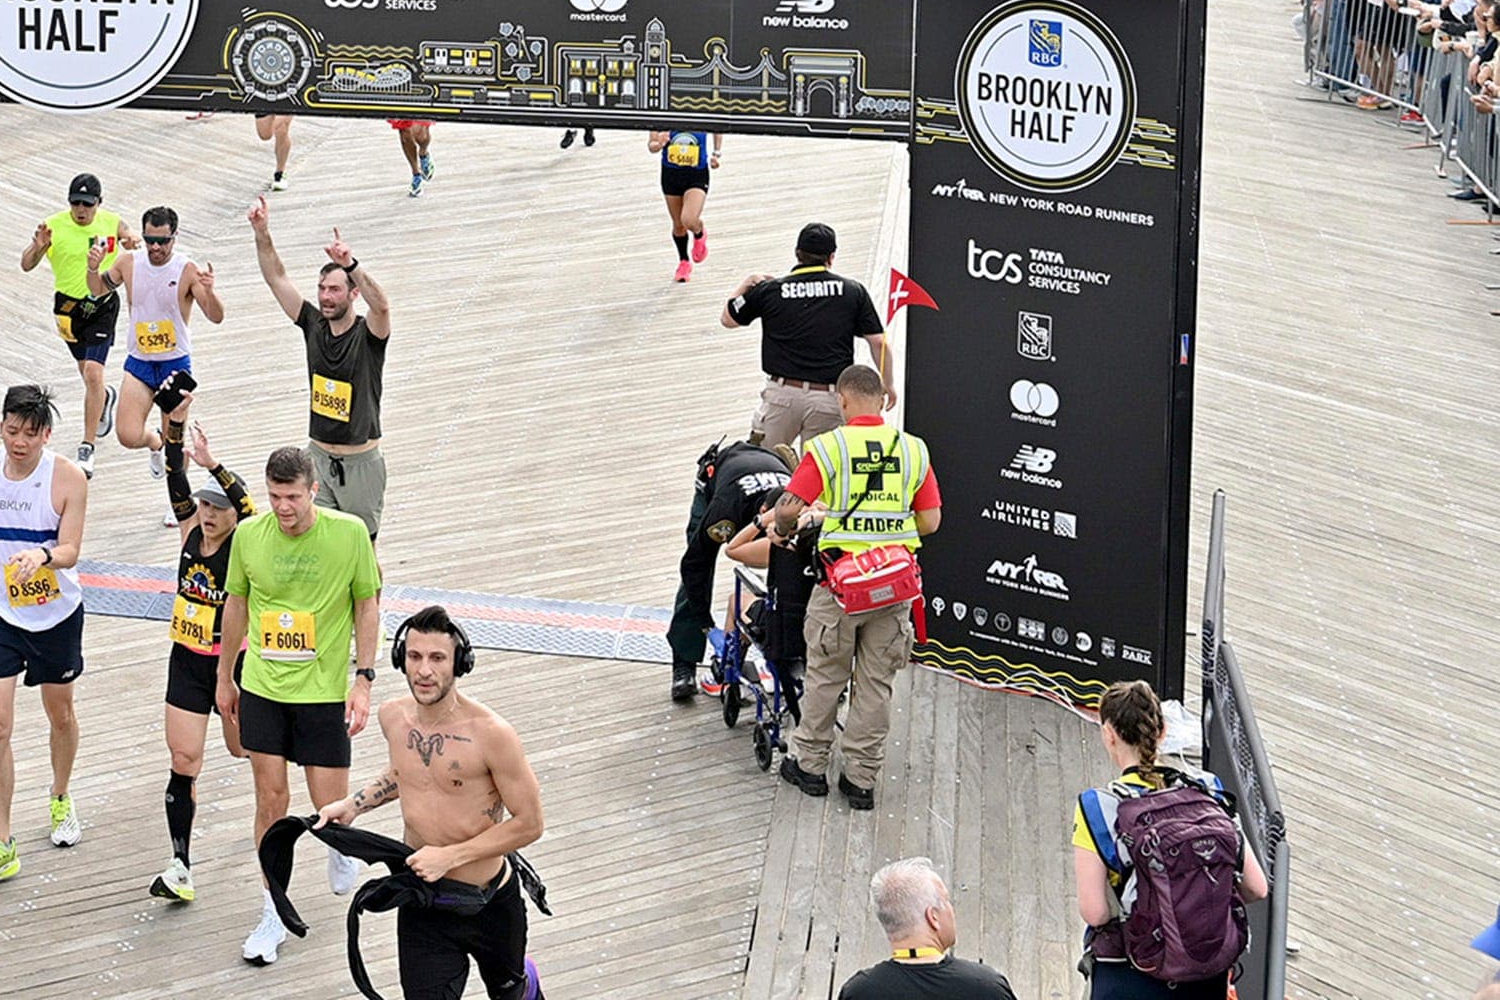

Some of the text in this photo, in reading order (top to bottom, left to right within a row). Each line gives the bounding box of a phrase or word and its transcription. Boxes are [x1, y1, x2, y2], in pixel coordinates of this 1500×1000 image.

[569, 12, 627, 22] mastercard
[762, 14, 849, 30] new balance
[17, 6, 120, 53] HALF
[1031, 51, 1060, 66] RBC
[977, 71, 1113, 117] BROOKLYN
[1010, 108, 1076, 144] HALF
[989, 192, 1018, 207] NEW
[1020, 196, 1055, 212] YORK
[1056, 202, 1093, 219] ROAD
[1094, 207, 1155, 227] RUNNERS
[967, 238, 1023, 284] tcs
[1028, 247, 1065, 265] TATA
[1028, 261, 1112, 287] CONSULTANCY
[781, 280, 844, 300] SECURITY
[1028, 276, 1081, 295] SERVICES
[1021, 342, 1047, 357] RBC
[1010, 411, 1057, 428] mastercard
[1000, 468, 1063, 490] new balance
[980, 507, 1051, 532] AIRLINES
[994, 499, 1051, 520] UNITED
[843, 516, 905, 533] LEADER
[9, 578, 51, 598] D 8586
[180, 619, 205, 640] 9781
[264, 632, 308, 649] F 6061
[1121, 648, 1153, 666] PARK
